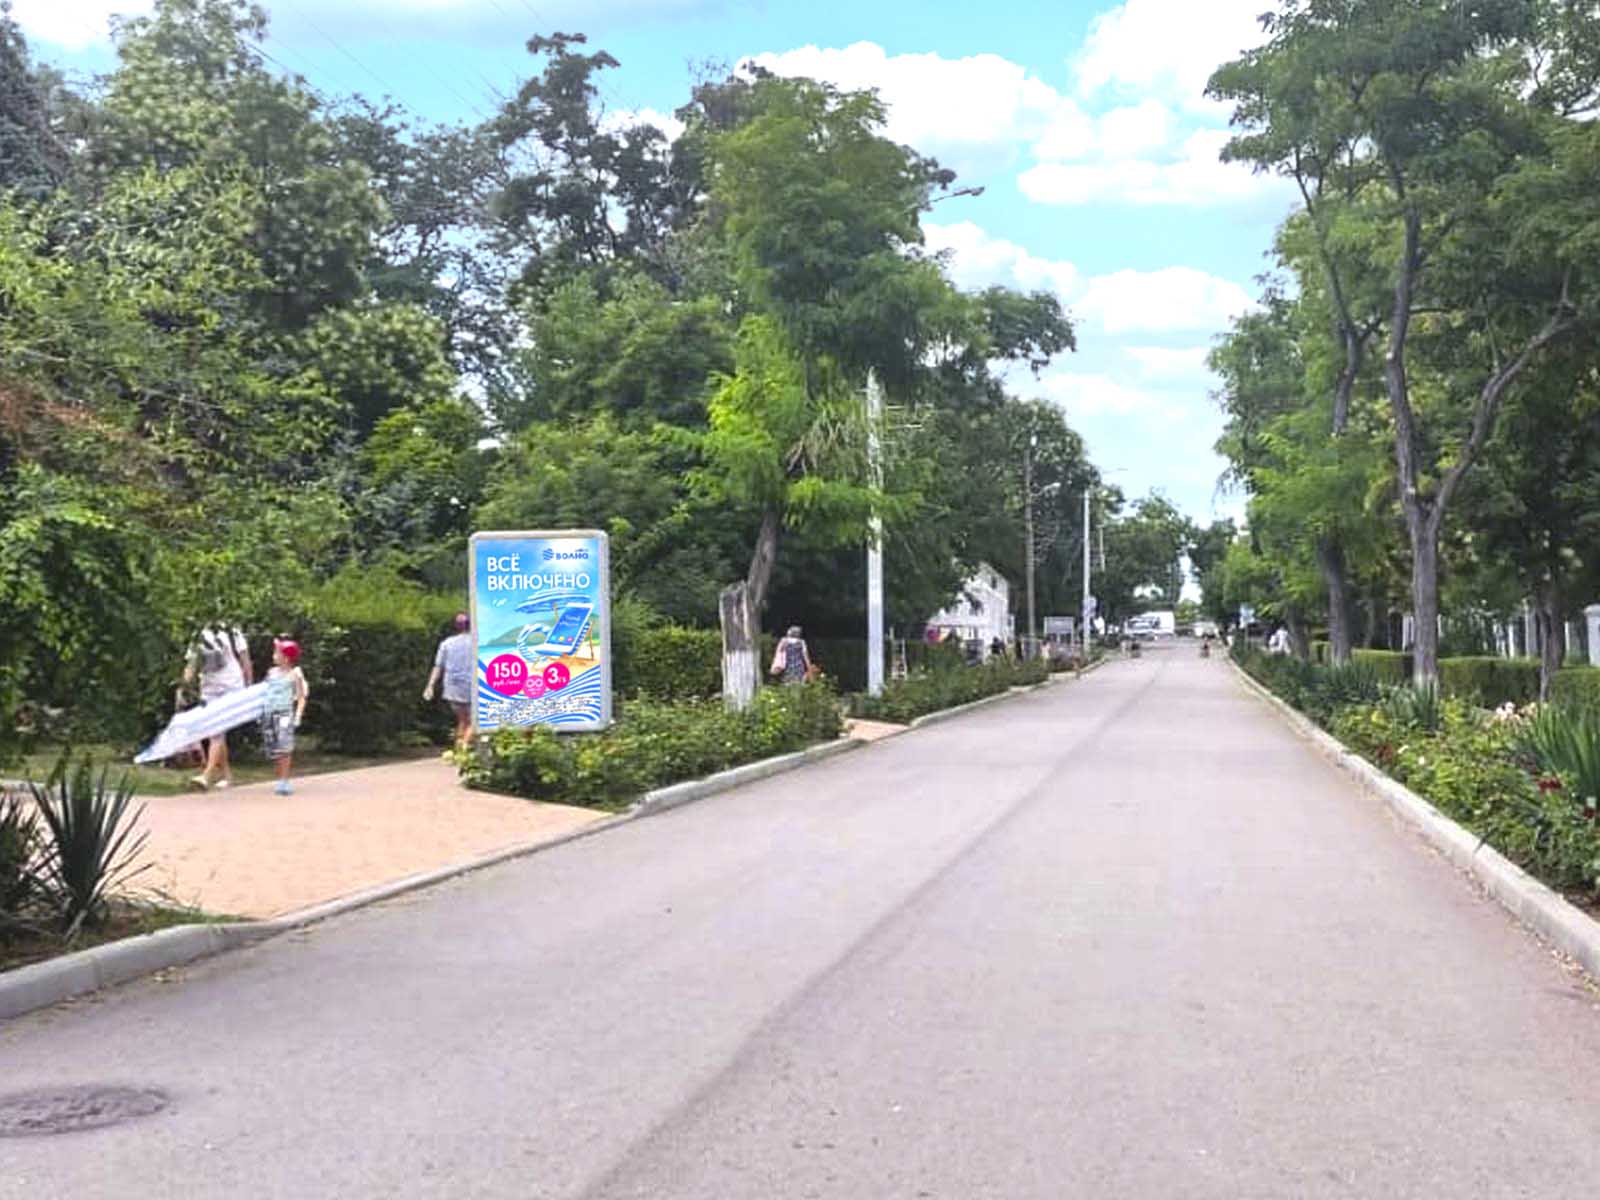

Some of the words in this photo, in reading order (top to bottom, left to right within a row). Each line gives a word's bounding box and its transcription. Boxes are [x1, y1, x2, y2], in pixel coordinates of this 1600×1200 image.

[487, 553, 520, 572] ВСЁ
[487, 573, 591, 591] ВКЛЮЧЕНО
[493, 662, 522, 678] 150
[547, 667, 559, 684] 3
